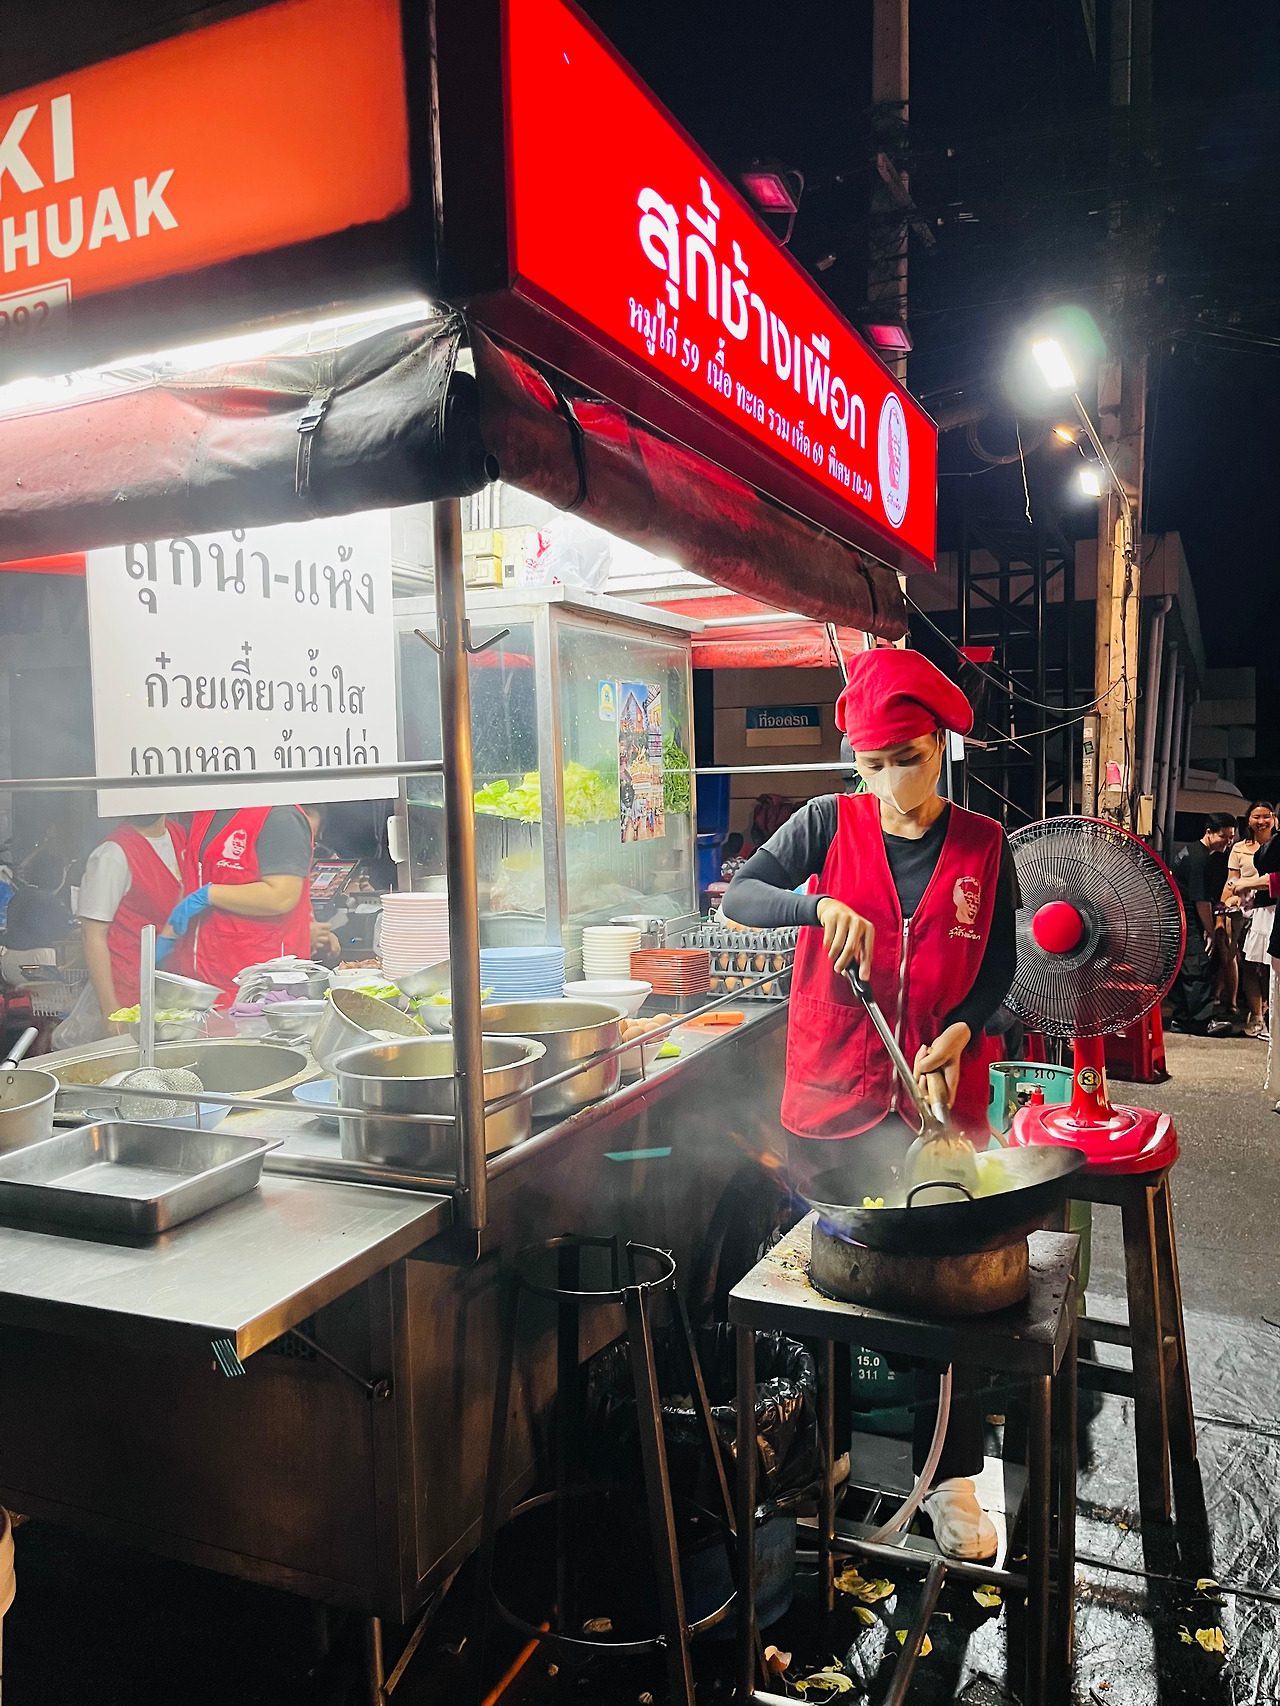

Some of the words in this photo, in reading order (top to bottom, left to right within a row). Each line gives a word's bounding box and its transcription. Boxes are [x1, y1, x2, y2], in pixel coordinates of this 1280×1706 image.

[2, 169, 179, 273] HUAK
[637, 176, 866, 449] สุกี้ช้างเผือก
[629, 297, 678, 358] หมูไก่
[681, 337, 700, 373] 59
[707, 337, 732, 399] เนื้อ
[736, 381, 765, 425] ทะเล
[768, 407, 790, 443] รวม
[791, 420, 811, 459] เห็ด
[812, 441, 824, 467] 69
[851, 471, 873, 503] 10-20
[145, 641, 366, 715] ก๋วยเตี๋ยวน้ำใส
[856, 1355, 880, 1367] 15.0
[858, 1369, 877, 1380] 31.1
